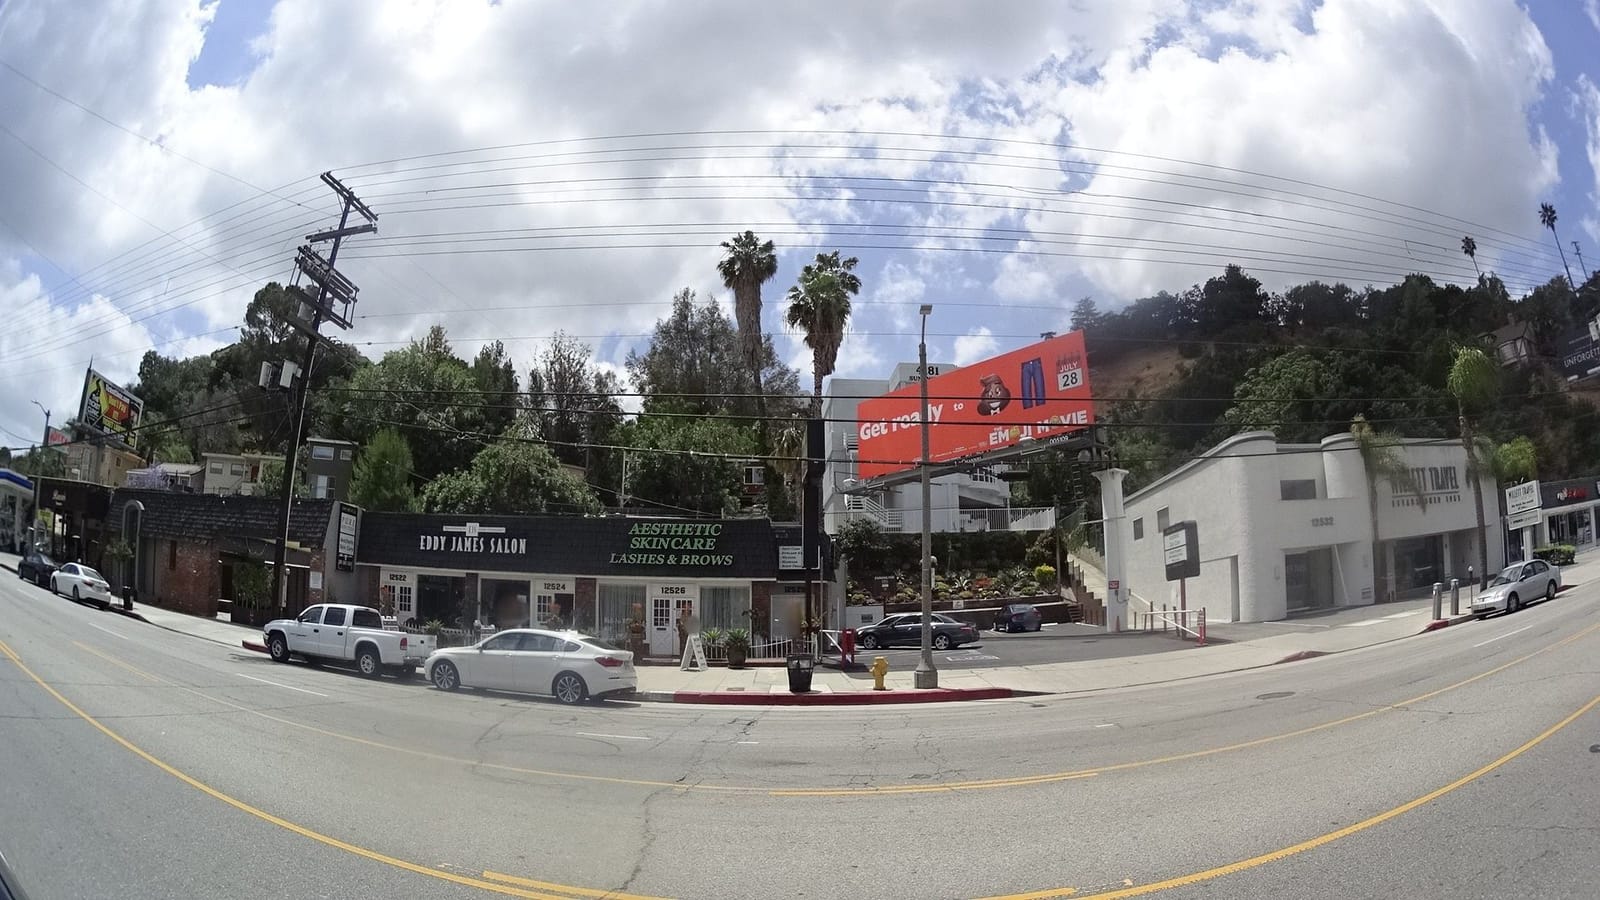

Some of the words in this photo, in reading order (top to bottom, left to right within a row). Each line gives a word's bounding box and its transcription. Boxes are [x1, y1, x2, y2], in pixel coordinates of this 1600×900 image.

[1060, 361, 1078, 373] JULY
[1062, 371, 1078, 387] 28
[860, 418, 888, 440] Get
[953, 403, 964, 411] to
[629, 523, 722, 536] AESTHETIC
[420, 535, 446, 551] EDDY
[450, 536, 484, 553] JAMES
[490, 538, 527, 554] SALON
[609, 553, 665, 565] LASHES
[667, 554, 678, 565] &
[680, 554, 734, 566] BROWS
[543, 583, 567, 591] 12524
[661, 586, 686, 594] 12526
